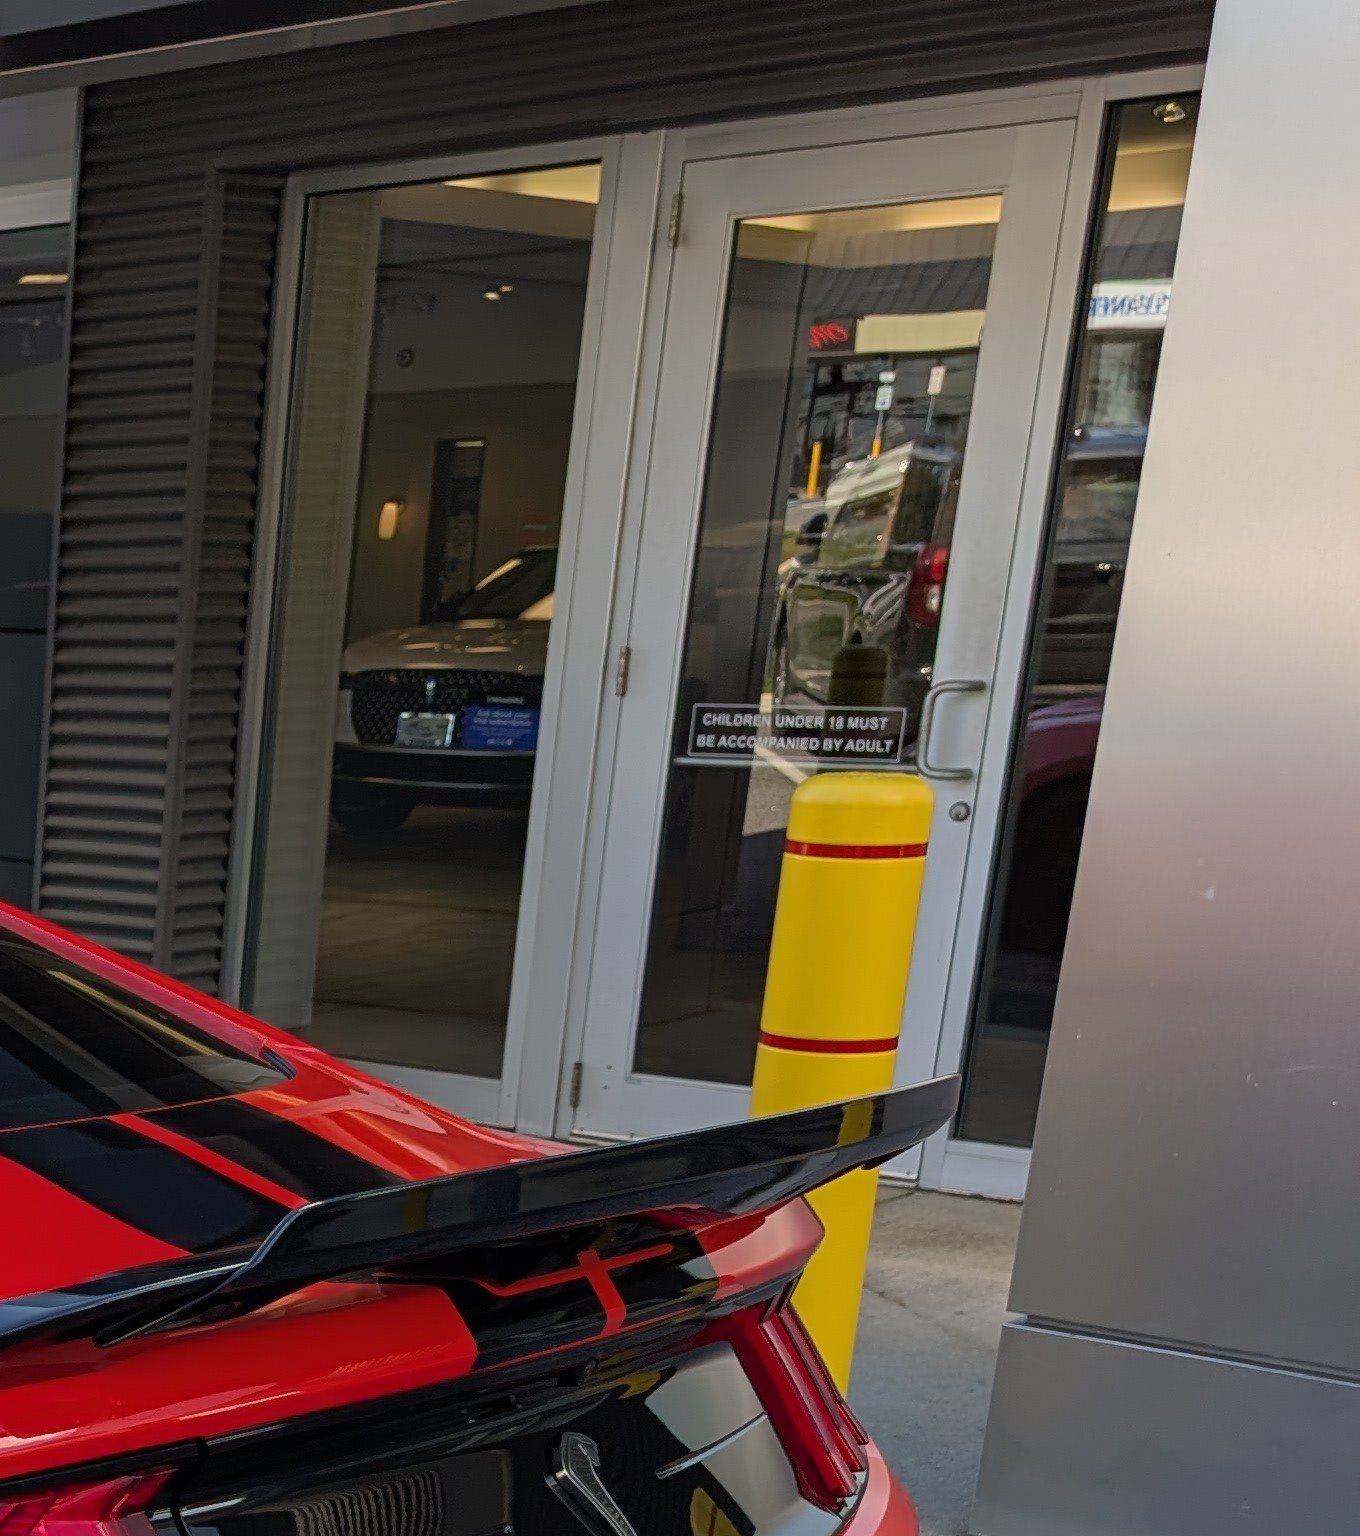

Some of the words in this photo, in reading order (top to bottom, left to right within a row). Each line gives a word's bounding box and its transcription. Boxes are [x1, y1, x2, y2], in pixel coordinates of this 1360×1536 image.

[702, 712, 771, 727] CHILDREN
[775, 714, 824, 729] UNDER
[829, 716, 845, 730] 18
[847, 716, 889, 731] MUST
[696, 734, 716, 748] BE
[717, 734, 820, 751] ACCOMPANIED
[823, 738, 844, 751] BY
[844, 739, 894, 753] ADULT
